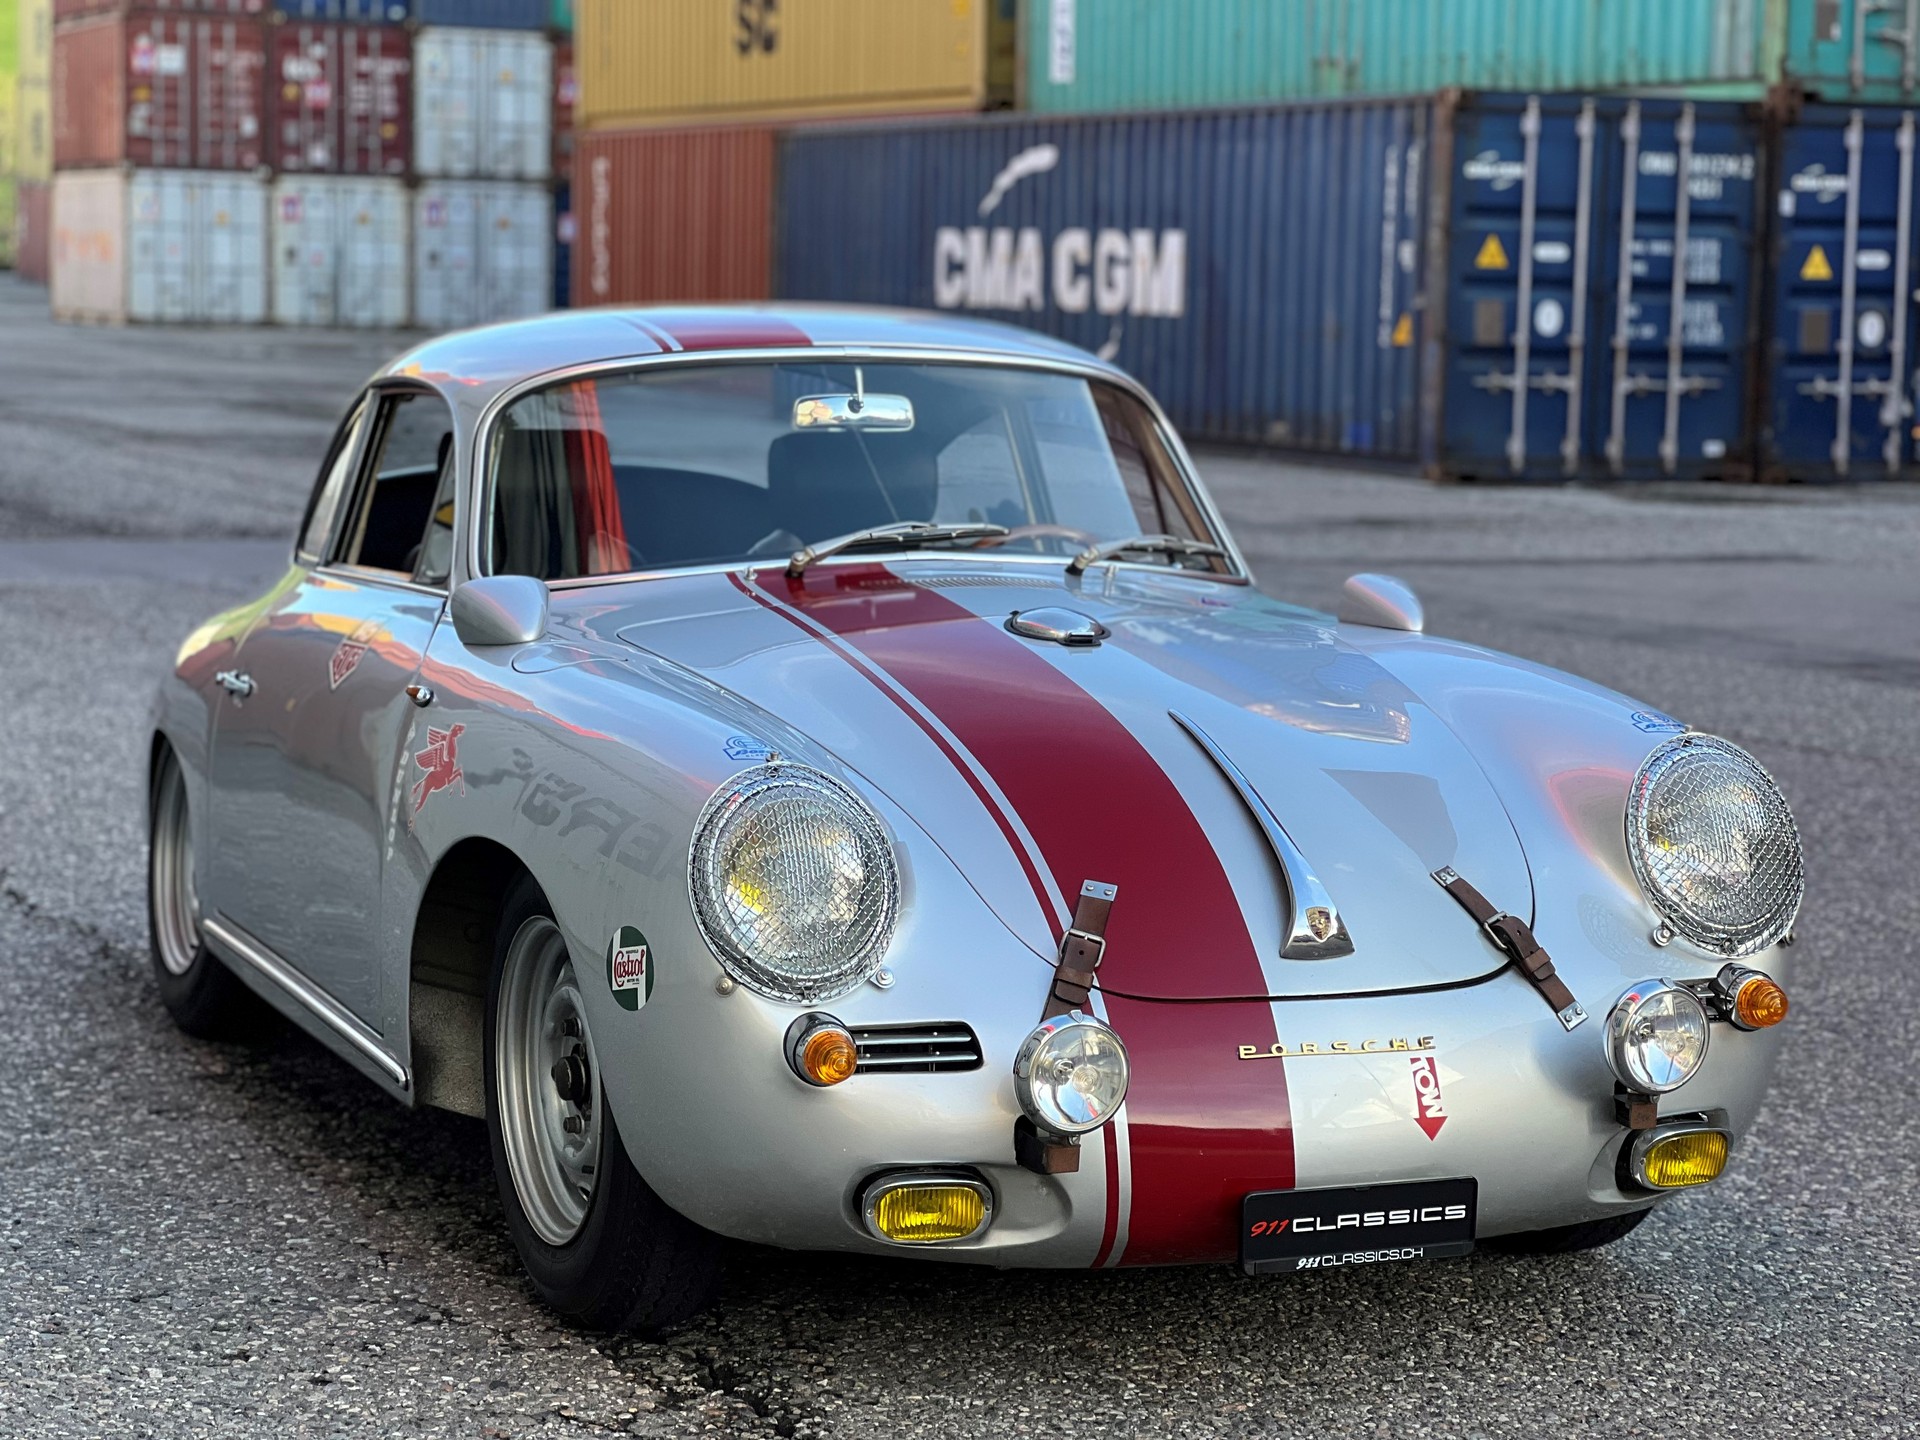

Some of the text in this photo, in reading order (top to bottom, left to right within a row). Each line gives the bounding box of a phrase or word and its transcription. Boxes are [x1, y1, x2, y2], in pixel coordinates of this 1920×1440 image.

[934, 226, 1186, 318] CMA CGM
[614, 949, 645, 988] Castrol
[1238, 1035, 1436, 1060] PORSCHE
[1410, 1056, 1444, 1118] TOW
[1250, 1205, 1467, 1238] 911 CLASSICS
